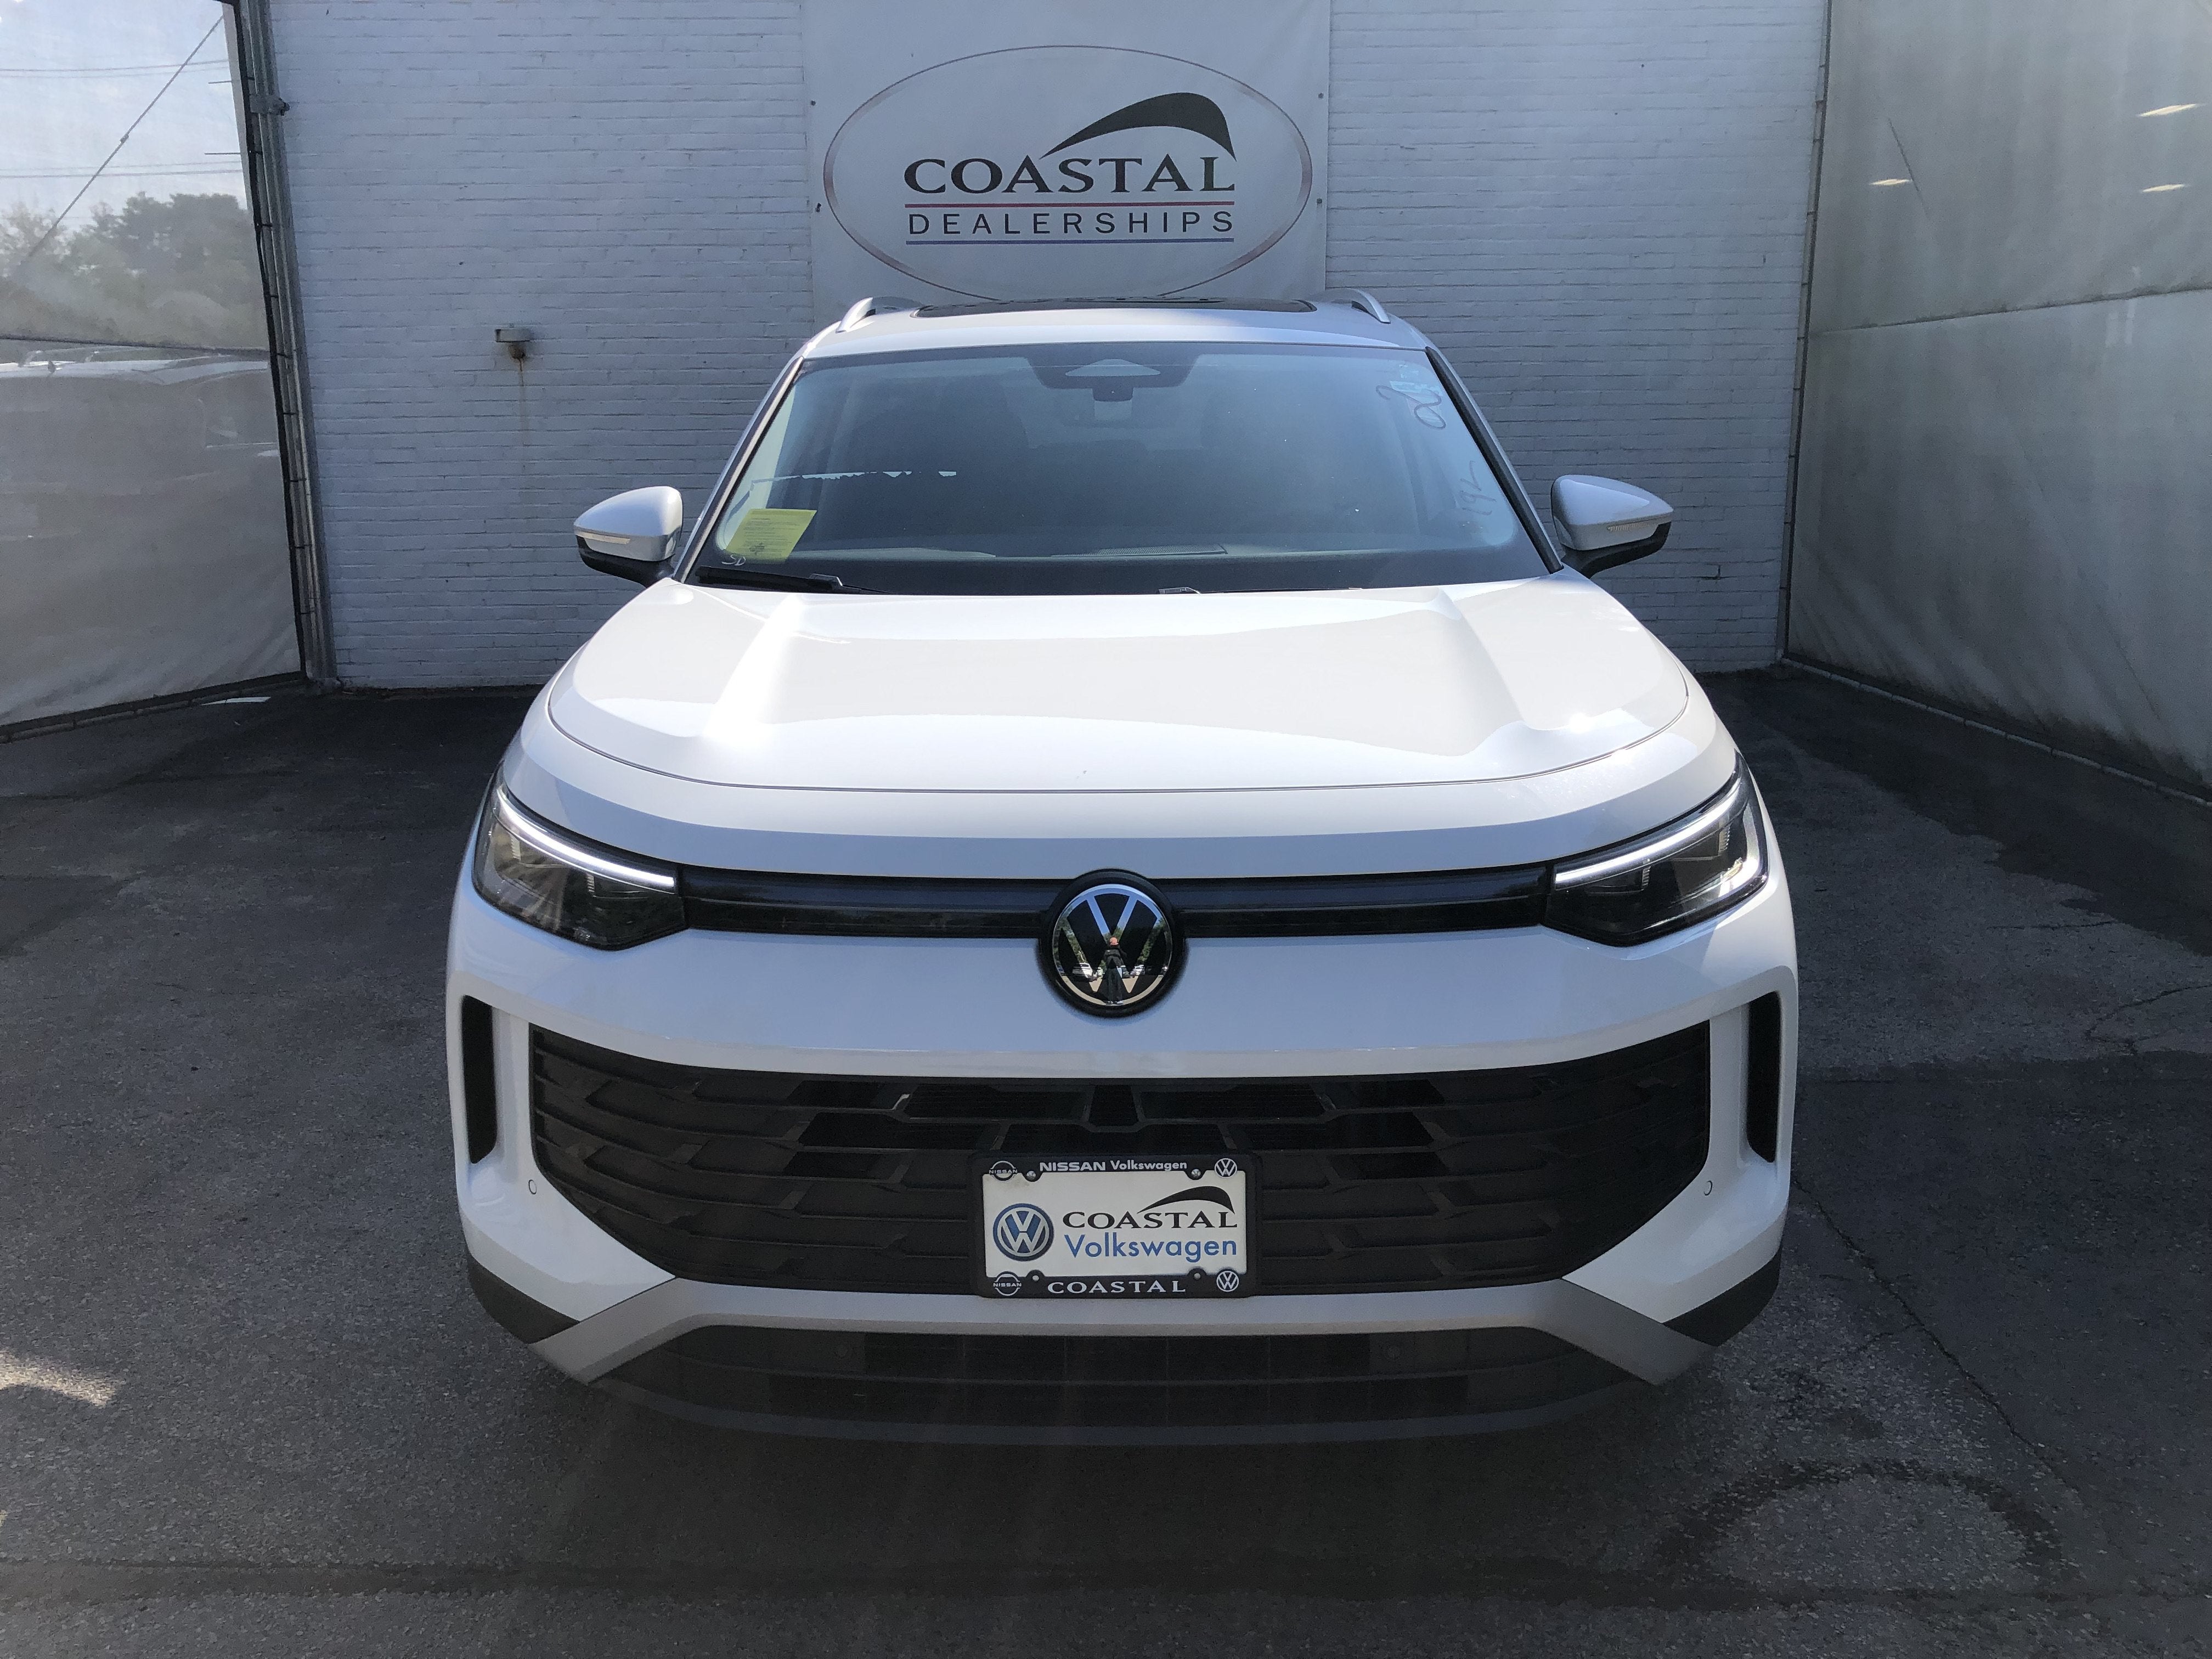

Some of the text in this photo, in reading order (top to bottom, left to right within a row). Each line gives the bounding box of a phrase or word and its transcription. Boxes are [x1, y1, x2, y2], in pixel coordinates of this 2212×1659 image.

[904, 154, 1235, 194] COASTAL
[909, 211, 1233, 235] DEALERSHIPS
[1040, 1160, 1187, 1171] NISSAN Volkswagen
[1063, 1211, 1238, 1229] COASTAL
[1064, 1232, 1237, 1262] Volkswagen
[1047, 1279, 1186, 1294] COASTAL
